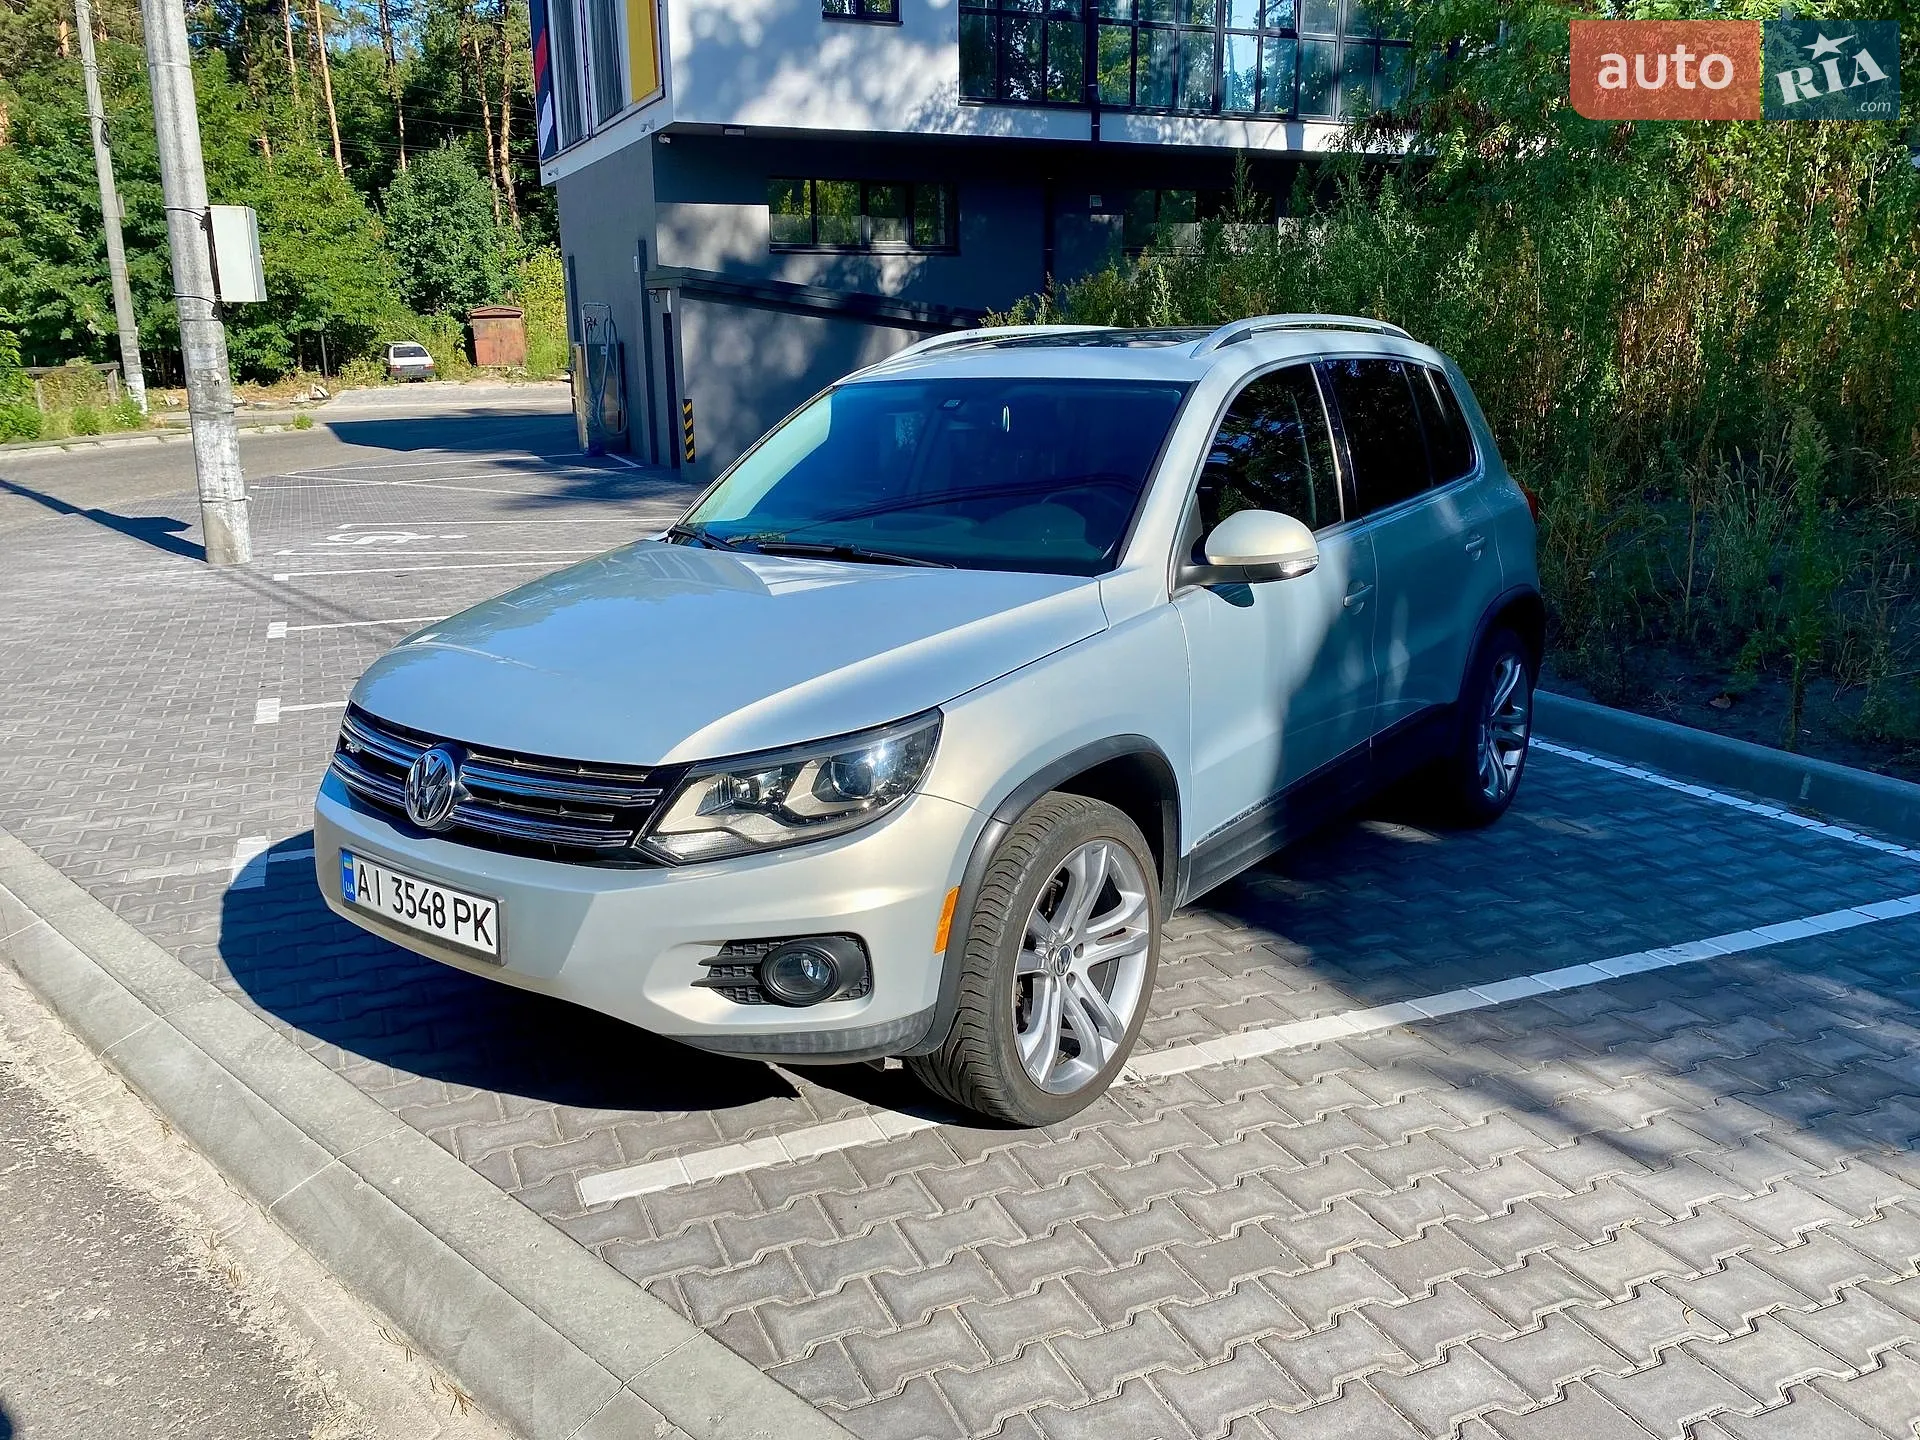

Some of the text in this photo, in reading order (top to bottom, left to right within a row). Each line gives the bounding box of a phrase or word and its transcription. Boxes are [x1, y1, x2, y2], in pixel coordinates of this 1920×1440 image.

[345, 881, 354, 894] UA
[358, 863, 494, 947] AI 3548 PK
